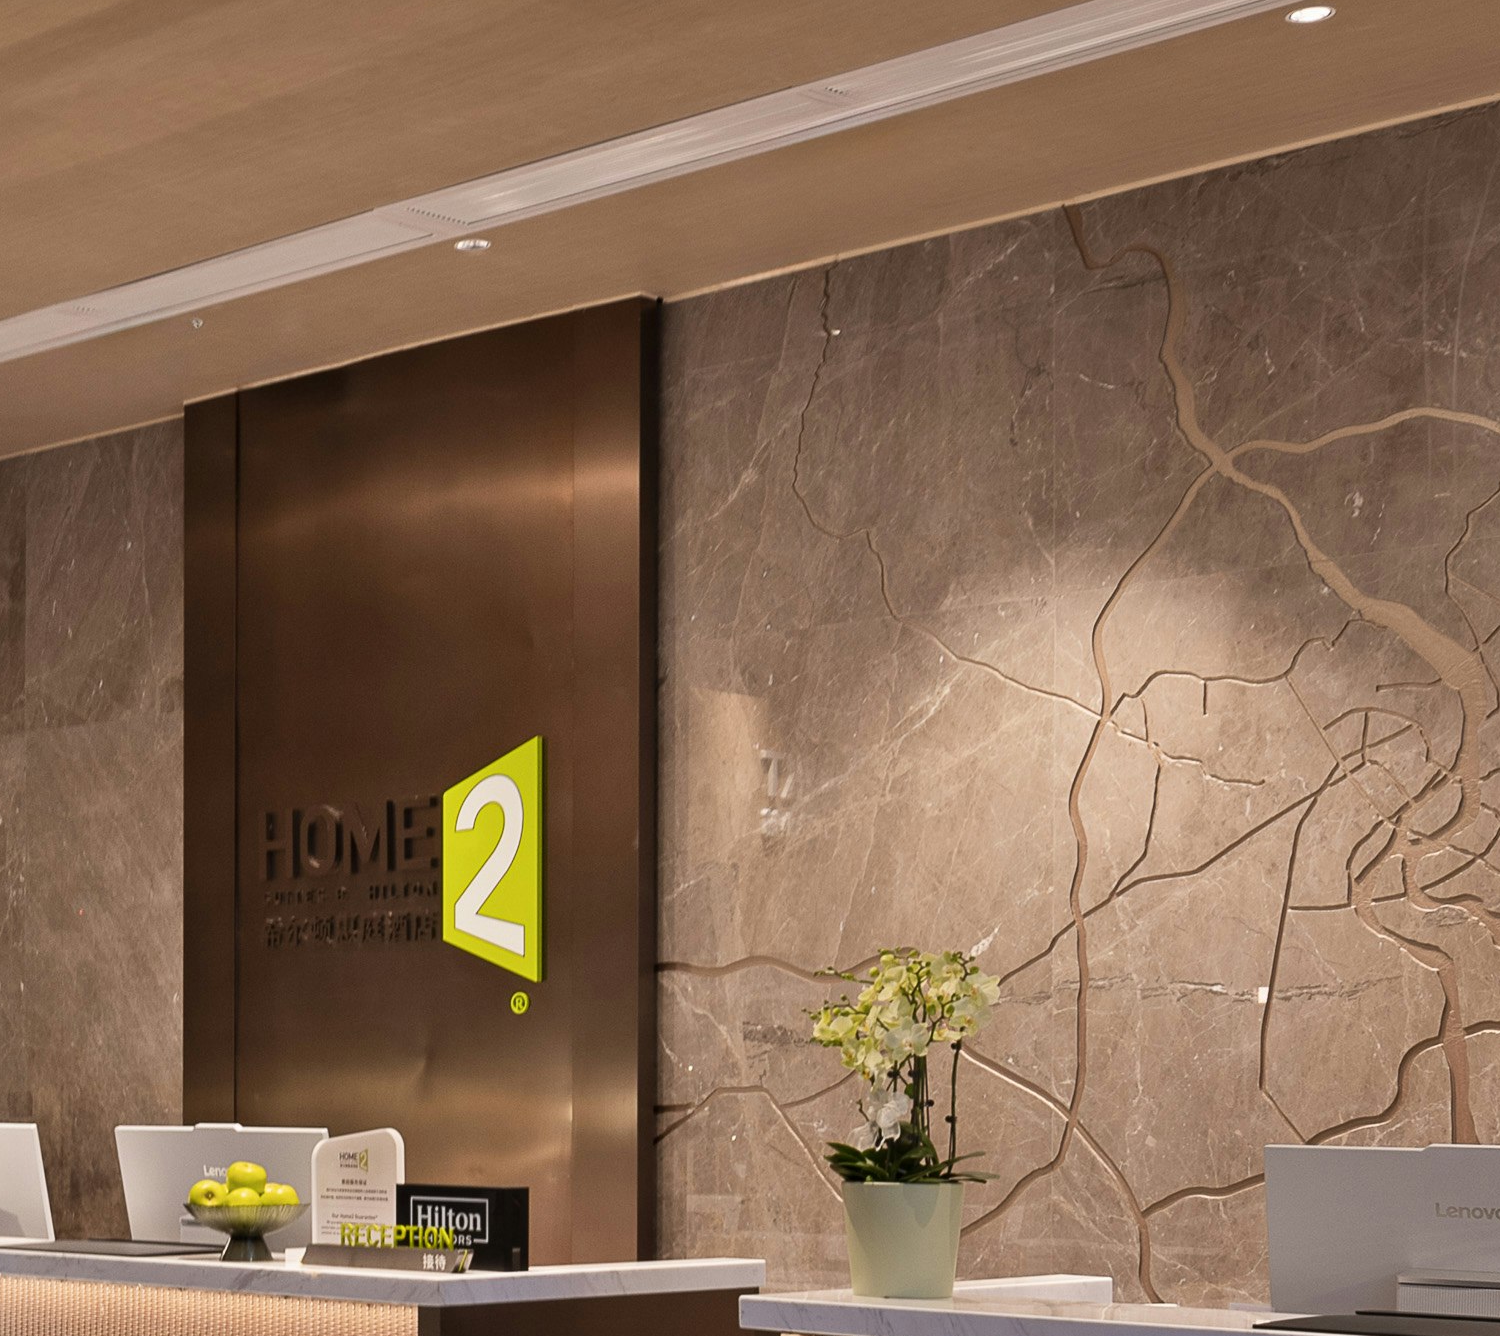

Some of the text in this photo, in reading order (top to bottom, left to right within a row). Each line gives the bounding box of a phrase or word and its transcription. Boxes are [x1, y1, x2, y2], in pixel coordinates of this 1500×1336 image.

[259, 773, 526, 957] HOME 2
[339, 1151, 358, 1161] HOME
[416, 1204, 483, 1232] Hilton
[340, 1222, 455, 1251] RECEPTION
[422, 1253, 447, 1271] 接待
